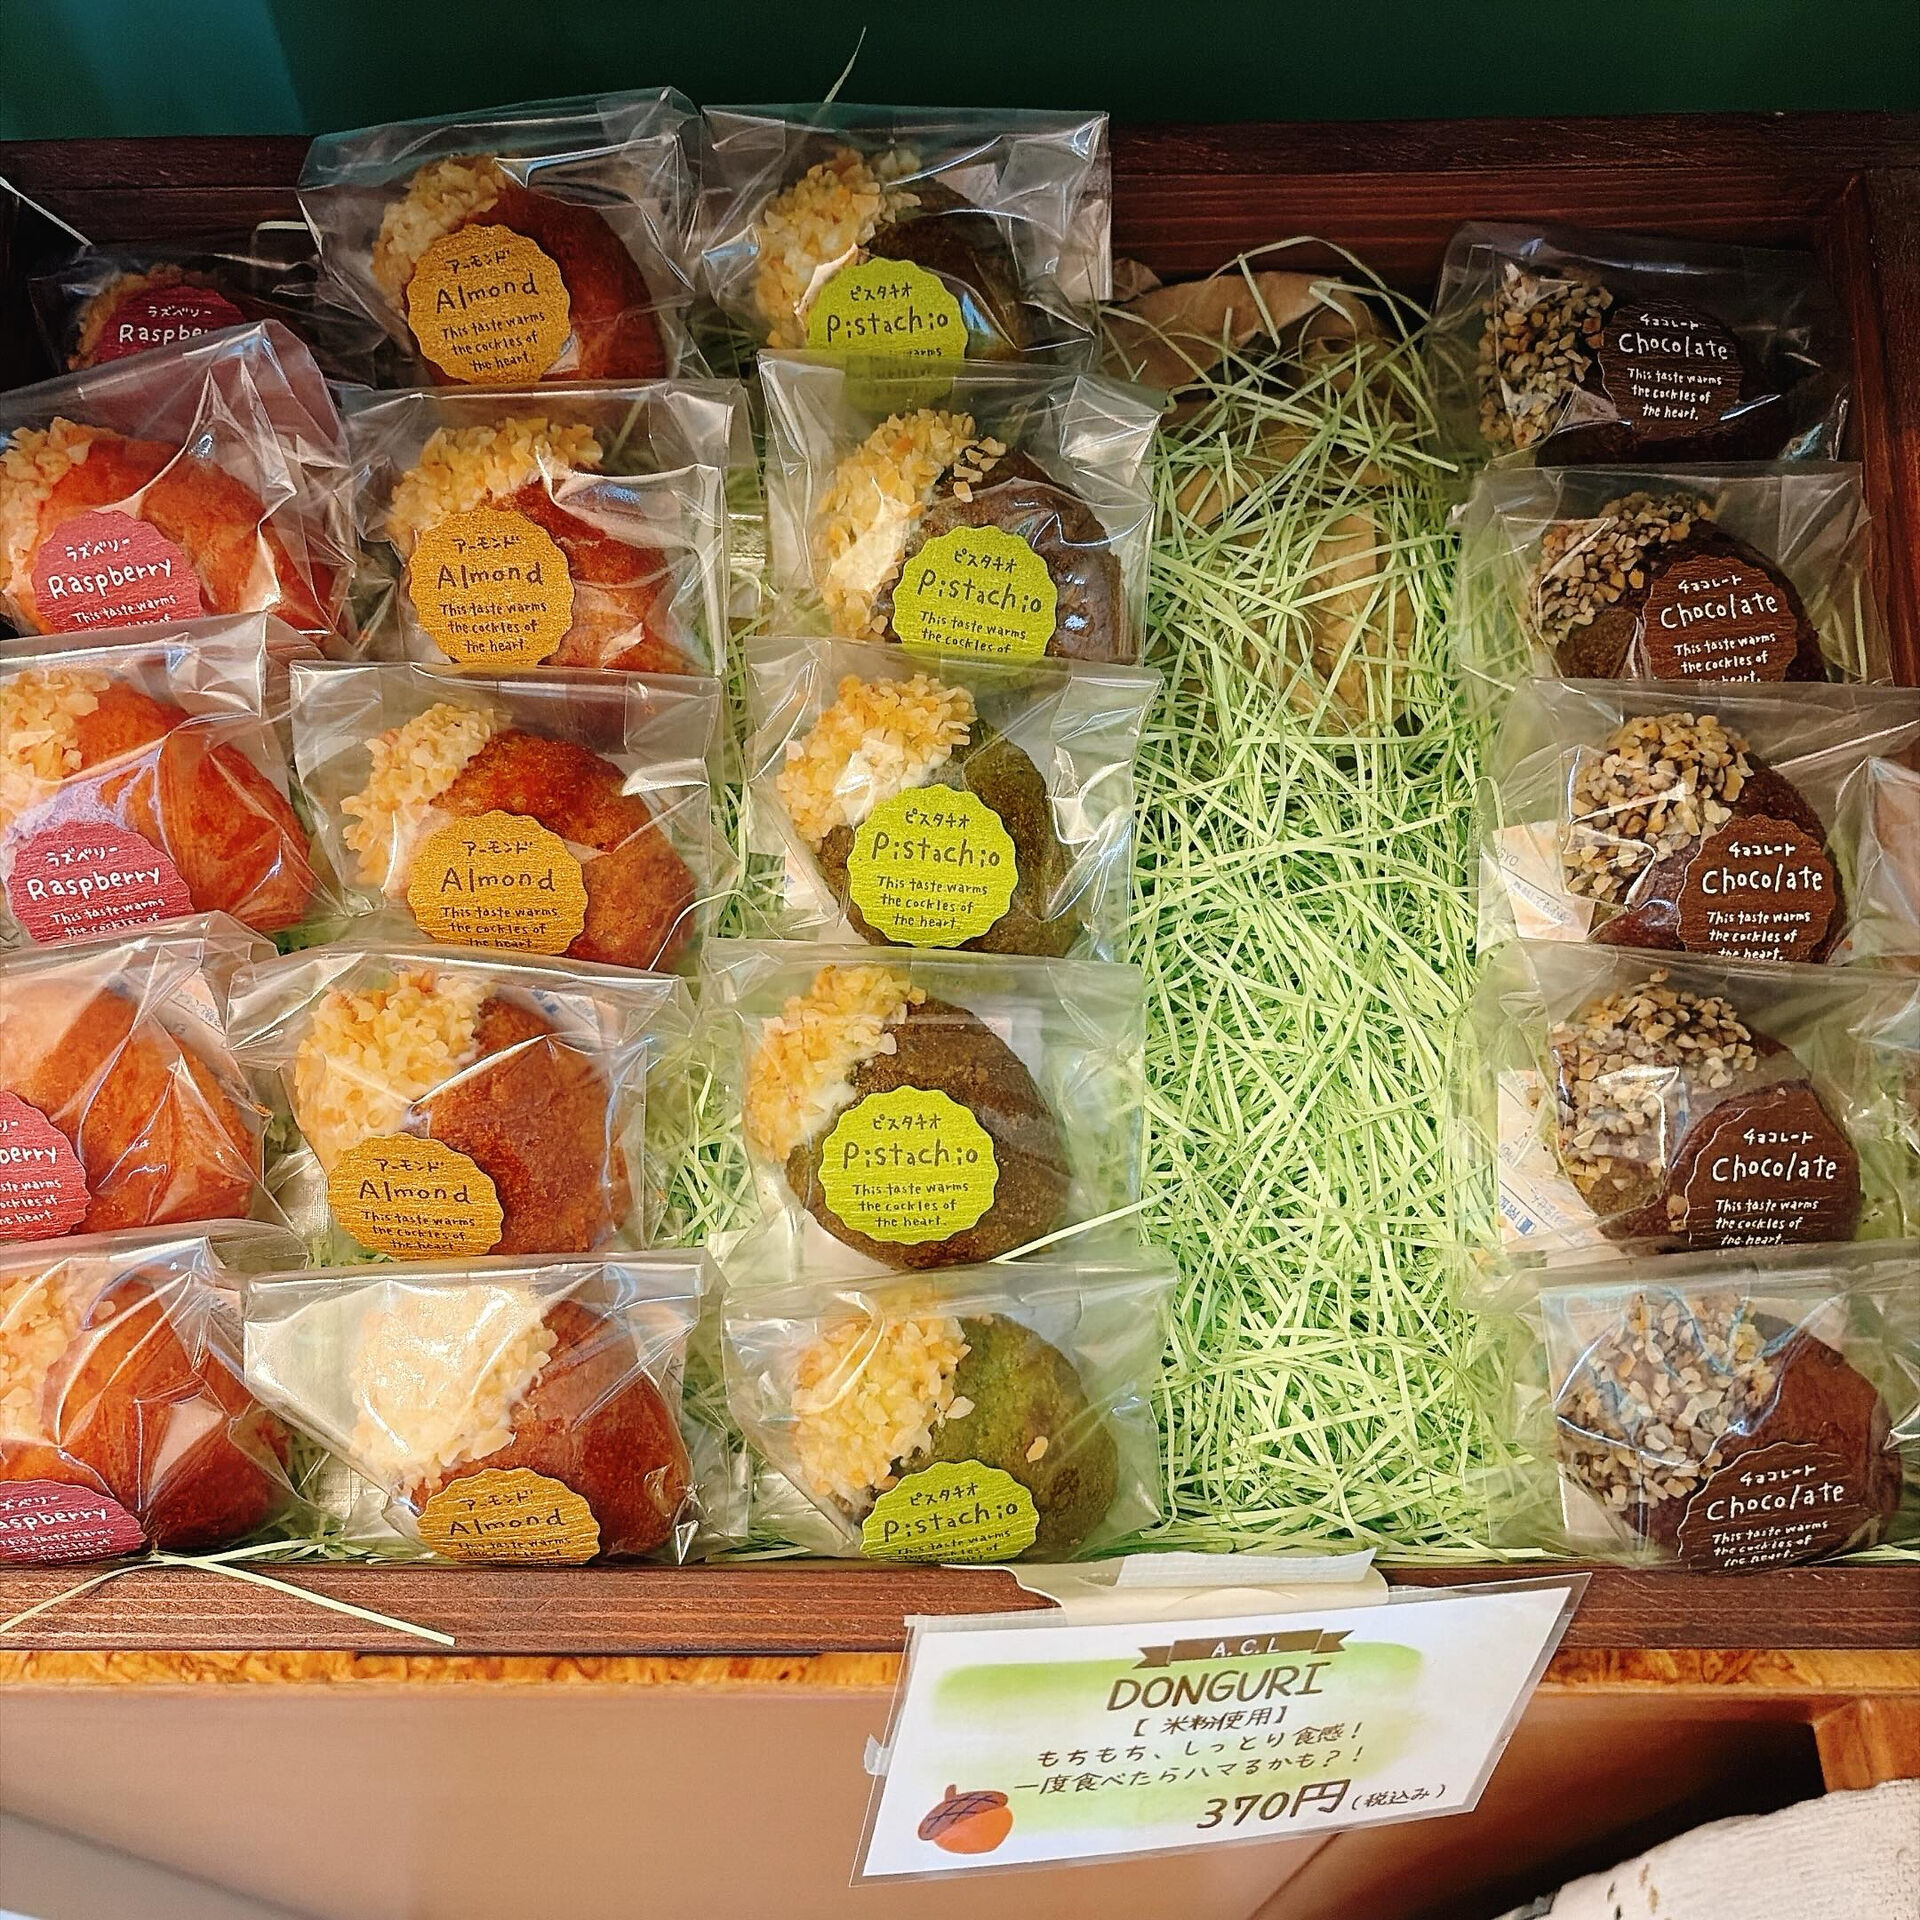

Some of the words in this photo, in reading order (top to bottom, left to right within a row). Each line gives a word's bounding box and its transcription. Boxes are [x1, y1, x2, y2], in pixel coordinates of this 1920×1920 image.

[437, 271, 539, 313] Almond
[851, 282, 912, 301] ピスタチオ
[148, 305, 212, 317] ラズベリー
[119, 325, 208, 344] Raspbe
[443, 326, 468, 340] This
[472, 319, 502, 335] taste
[506, 312, 545, 326] warms
[828, 305, 949, 342] Pistachio
[452, 343, 472, 355] the
[476, 338, 522, 352] cockles
[526, 330, 538, 343] of
[909, 348, 942, 356] arms
[1619, 333, 1727, 360] Chocolate
[1627, 368, 1652, 381] This
[1656, 370, 1683, 383] taste
[1687, 375, 1722, 385] warms
[1632, 385, 1650, 397] the
[1653, 390, 1696, 402] cockles
[1700, 391, 1711, 404] of
[1643, 404, 1660, 417] the
[65, 539, 130, 562] ラズベリー
[48, 559, 172, 599] Raspberry
[438, 562, 543, 589] Almond
[917, 569, 1042, 613] Pistachio
[72, 611, 100, 624] This
[101, 605, 133, 619] taste
[137, 595, 176, 611] warms
[440, 603, 467, 616] This
[469, 603, 502, 616] taste
[506, 602, 547, 613] warms
[1660, 594, 1778, 629] Chocolate
[448, 621, 468, 634] the
[472, 621, 520, 633] cockles
[524, 620, 538, 632] of
[920, 611, 946, 625] This
[951, 617, 983, 633] taste
[987, 625, 1026, 640] warms
[922, 628, 942, 641] the
[946, 636, 993, 652] cockles
[1674, 645, 1701, 657] This
[1705, 638, 1735, 653] taste
[1738, 633, 1776, 646] warms
[1681, 661, 1702, 673] the
[1705, 656, 1751, 671] cockles
[1756, 651, 1768, 664] of
[45, 847, 119, 867] ラズベリー
[872, 832, 1000, 868] Pistachio
[27, 868, 160, 900] Raspberry
[441, 868, 555, 892] Almond
[877, 876, 905, 889] This
[910, 878, 942, 892] taste
[947, 884, 987, 895] warms
[1702, 863, 1823, 894] Chocolate
[50, 914, 81, 924] This
[84, 906, 119, 920] taste
[122, 898, 165, 912] warms
[441, 907, 471, 919] This
[475, 907, 511, 918] taste
[515, 908, 558, 916] warms
[880, 894, 901, 906] the
[906, 899, 955, 912] cockles
[961, 902, 974, 914] of
[450, 923, 471, 933] the
[476, 924, 528, 934] cockles
[532, 923, 547, 934] of
[894, 914, 914, 925] the
[1707, 911, 1734, 924] This
[1738, 911, 1769, 924] taste
[1773, 912, 1810, 922] warms
[1709, 930, 1729, 942] the
[1732, 931, 1780, 942] cockles
[1784, 929, 1798, 942] of
[1719, 948, 1739, 956] the
[843, 1139, 978, 1169] Pistachio
[1713, 1152, 1837, 1182] Chocolate
[22, 1180, 62, 1189] warms
[360, 1180, 472, 1204] Almond
[852, 1184, 882, 1196] This
[888, 1183, 921, 1195] taste
[926, 1183, 969, 1193] warms
[859, 1201, 881, 1211] the
[886, 1202, 938, 1211] cockles
[944, 1200, 957, 1210] of
[1716, 1199, 1741, 1213] This
[1746, 1199, 1776, 1211] taste
[1781, 1200, 1819, 1210] warms
[361, 1210, 391, 1221] This
[394, 1213, 429, 1225] taste
[433, 1217, 475, 1226] warms
[875, 1218, 897, 1227] the
[1716, 1217, 1734, 1229] the
[1738, 1218, 1785, 1229] cockles
[1789, 1217, 1803, 1229] of
[1740, 1465, 1816, 1486] チョコレート
[911, 1482, 978, 1506] ピスタチオ
[1707, 1482, 1844, 1520] Chocolate
[0, 1509, 106, 1530] aspberry
[450, 1508, 566, 1536] Almond
[884, 1503, 1018, 1542] Pistachio
[1107, 1662, 1331, 1711] DONGURI
